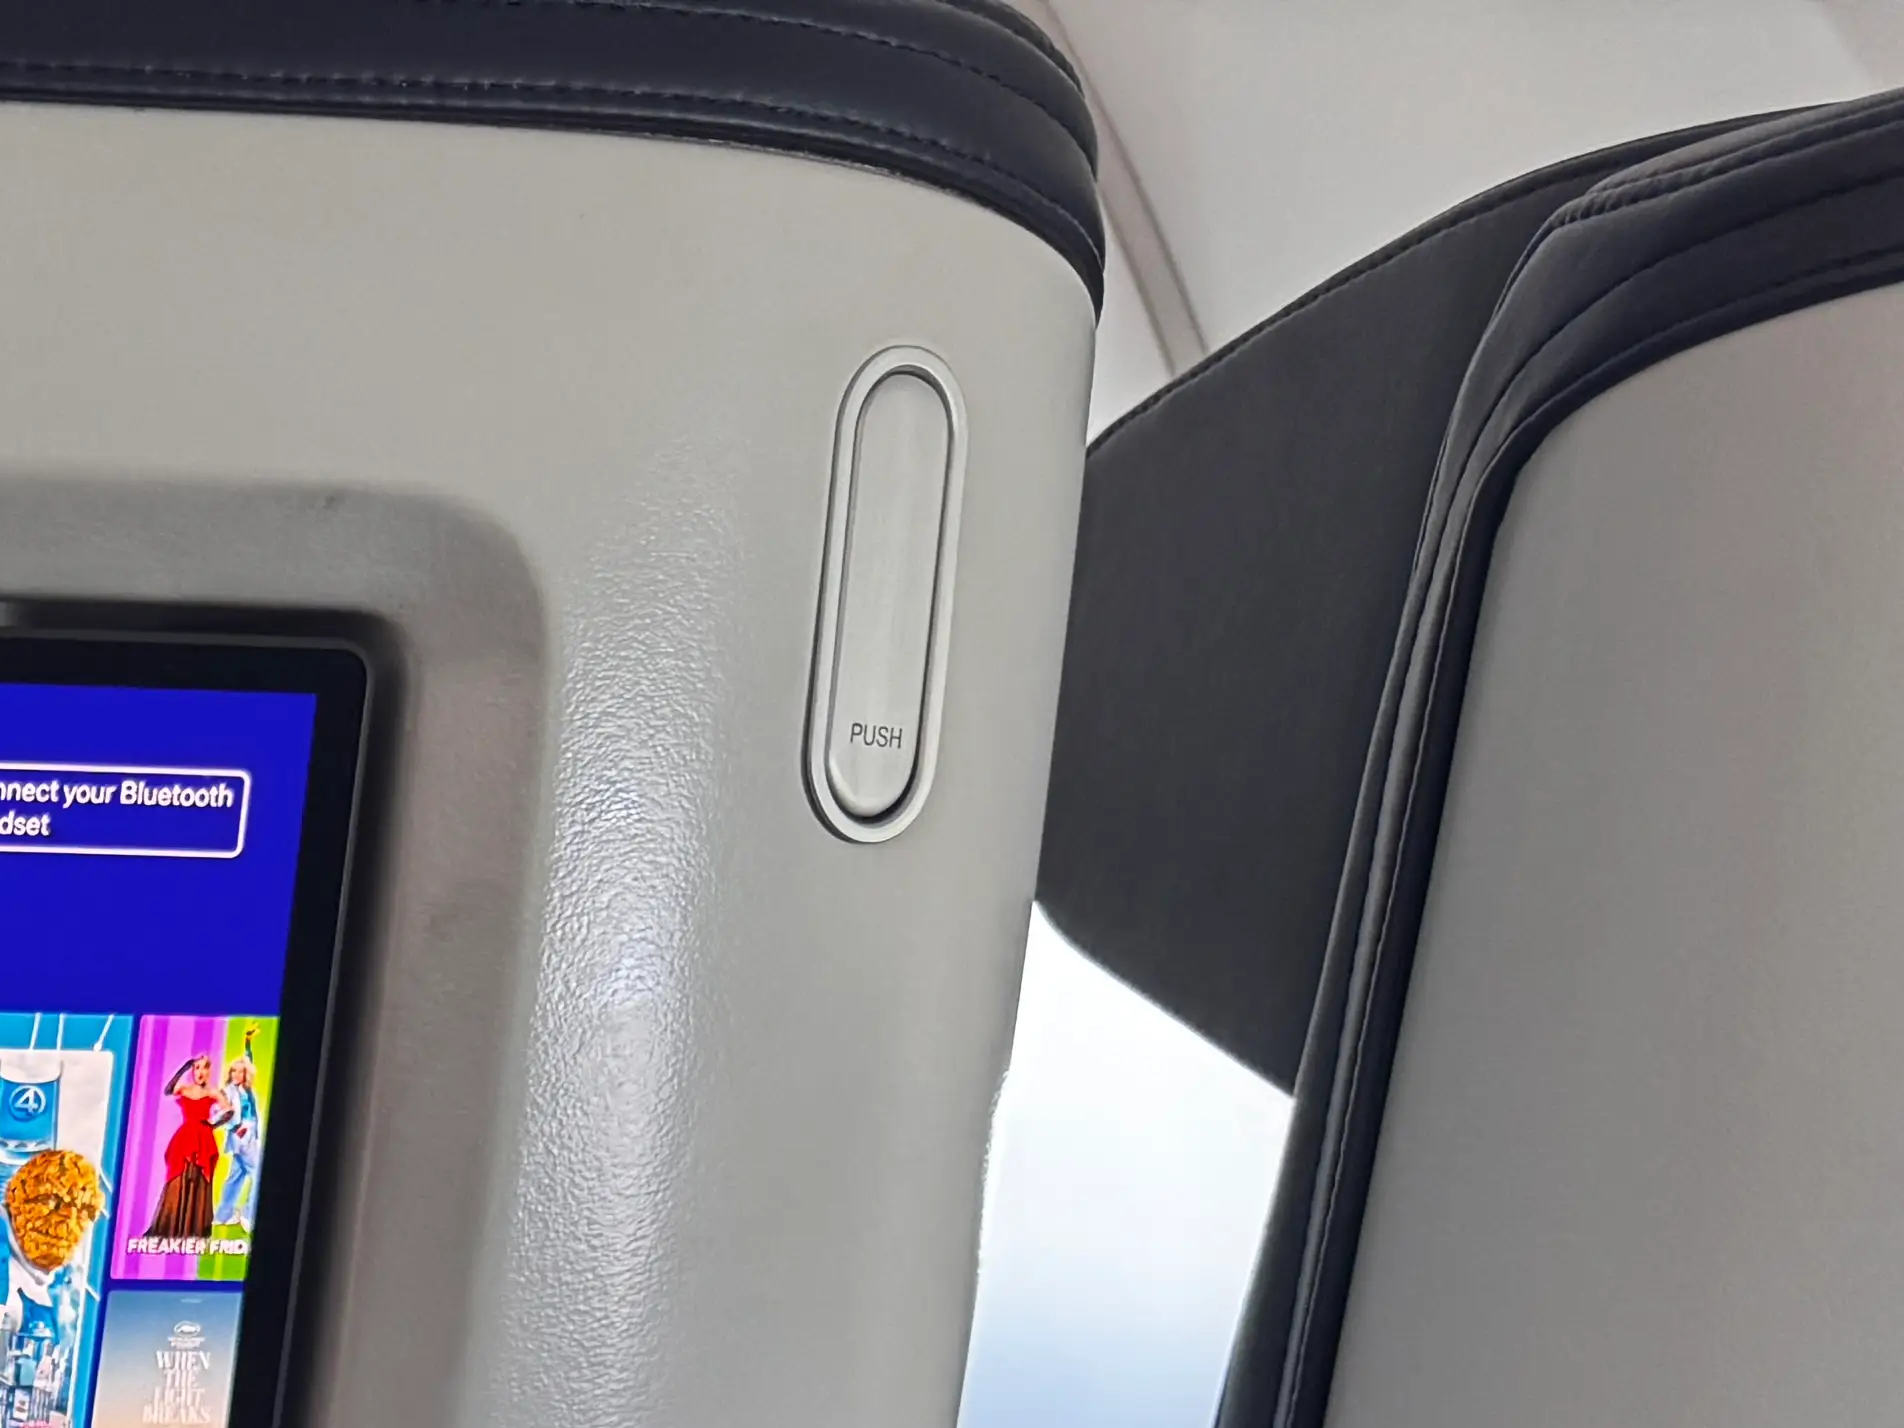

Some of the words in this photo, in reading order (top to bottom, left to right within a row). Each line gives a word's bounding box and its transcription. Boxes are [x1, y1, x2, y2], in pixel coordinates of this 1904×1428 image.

[849, 722, 903, 749] PUSH
[63, 784, 117, 808] your
[120, 780, 234, 807] Bluetooth
